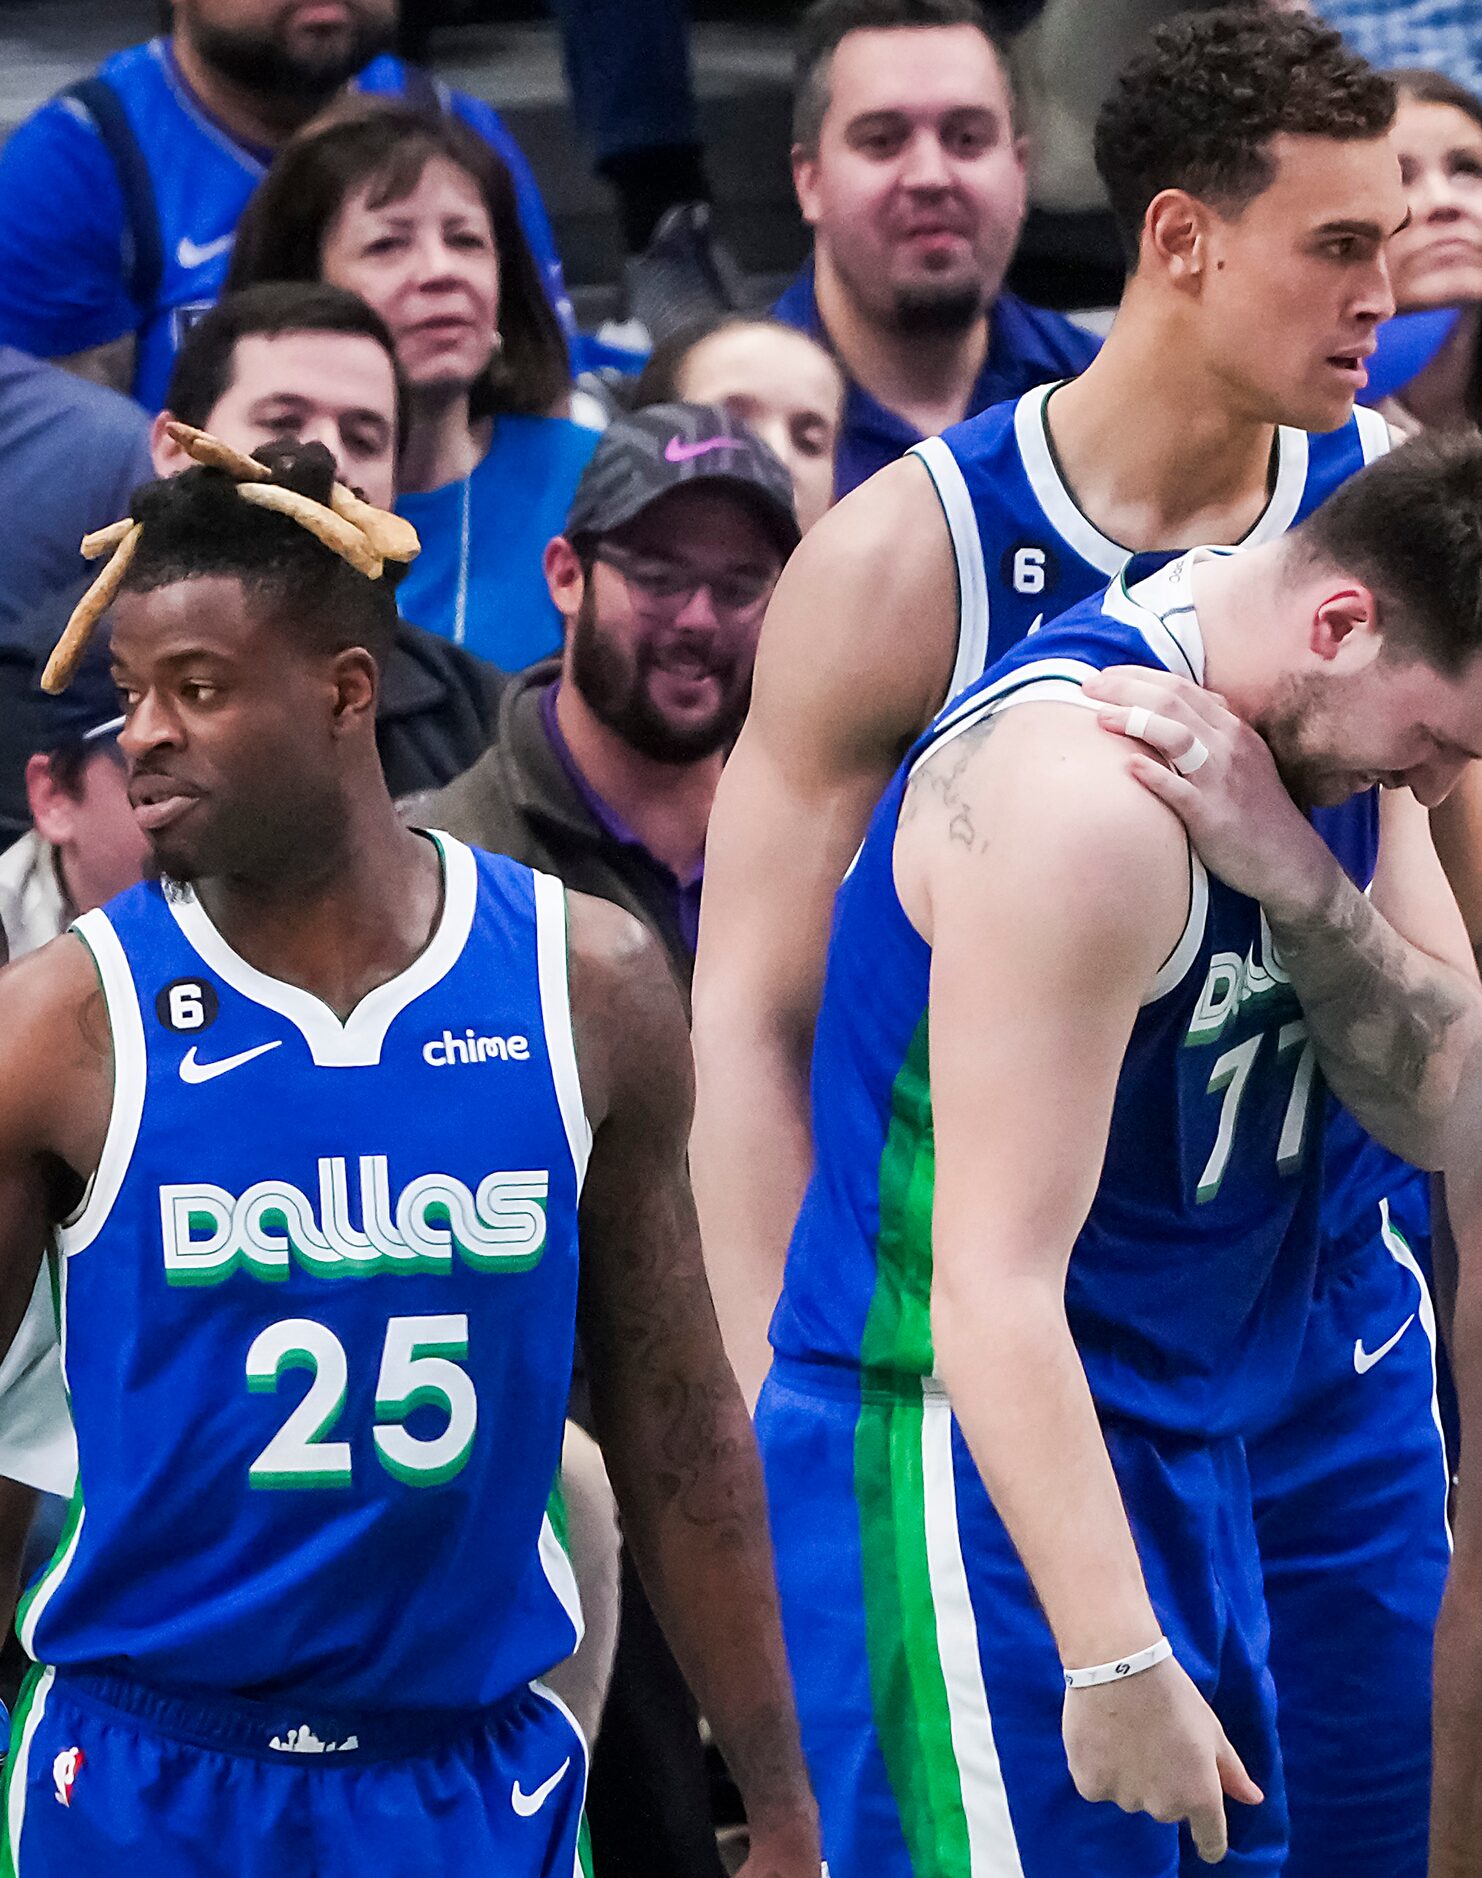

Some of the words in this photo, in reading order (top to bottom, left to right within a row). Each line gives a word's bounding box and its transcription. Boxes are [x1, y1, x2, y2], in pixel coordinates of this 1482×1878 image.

[1014, 548, 1045, 595] 6
[169, 984, 204, 1029] 6
[422, 1029, 531, 1067] chime
[159, 1155, 549, 1286] Dallas
[246, 1314, 477, 1489] 25
